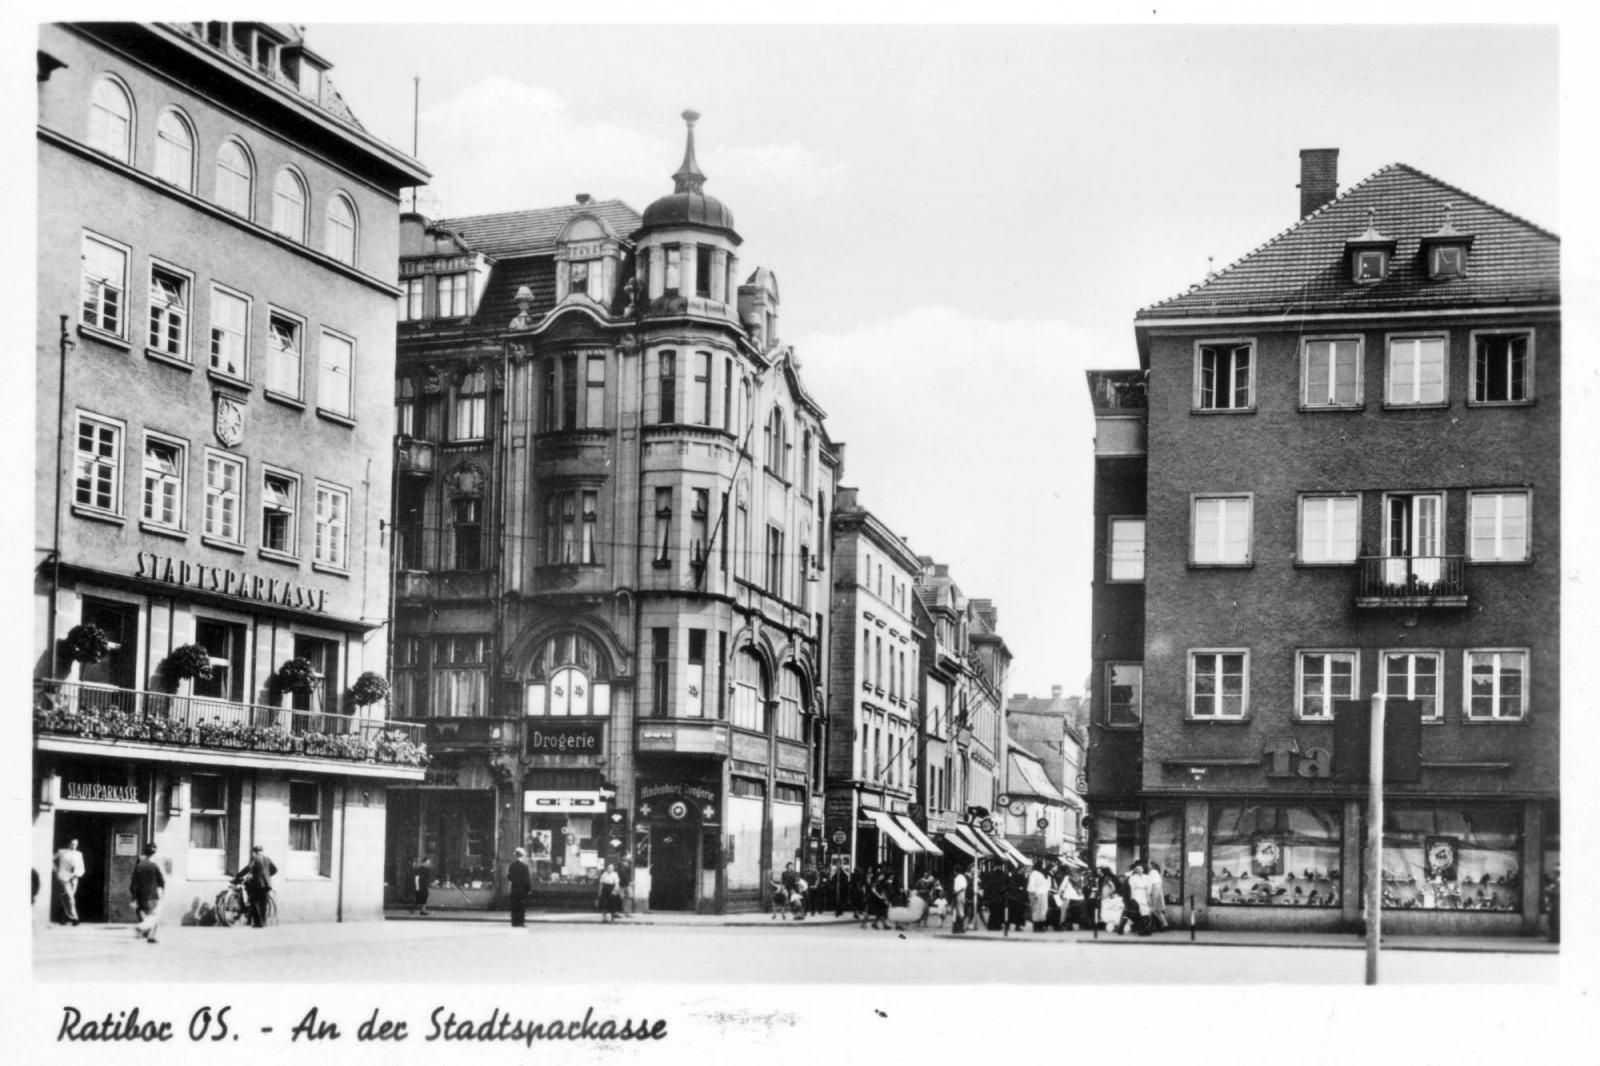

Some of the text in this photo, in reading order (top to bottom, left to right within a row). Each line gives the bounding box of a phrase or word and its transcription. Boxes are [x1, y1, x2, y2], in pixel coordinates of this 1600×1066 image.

[135, 551, 331, 614] STADTSPARKASSE
[533, 731, 595, 751] Drogerie
[67, 782, 138, 803] STADTSPARKASSE
